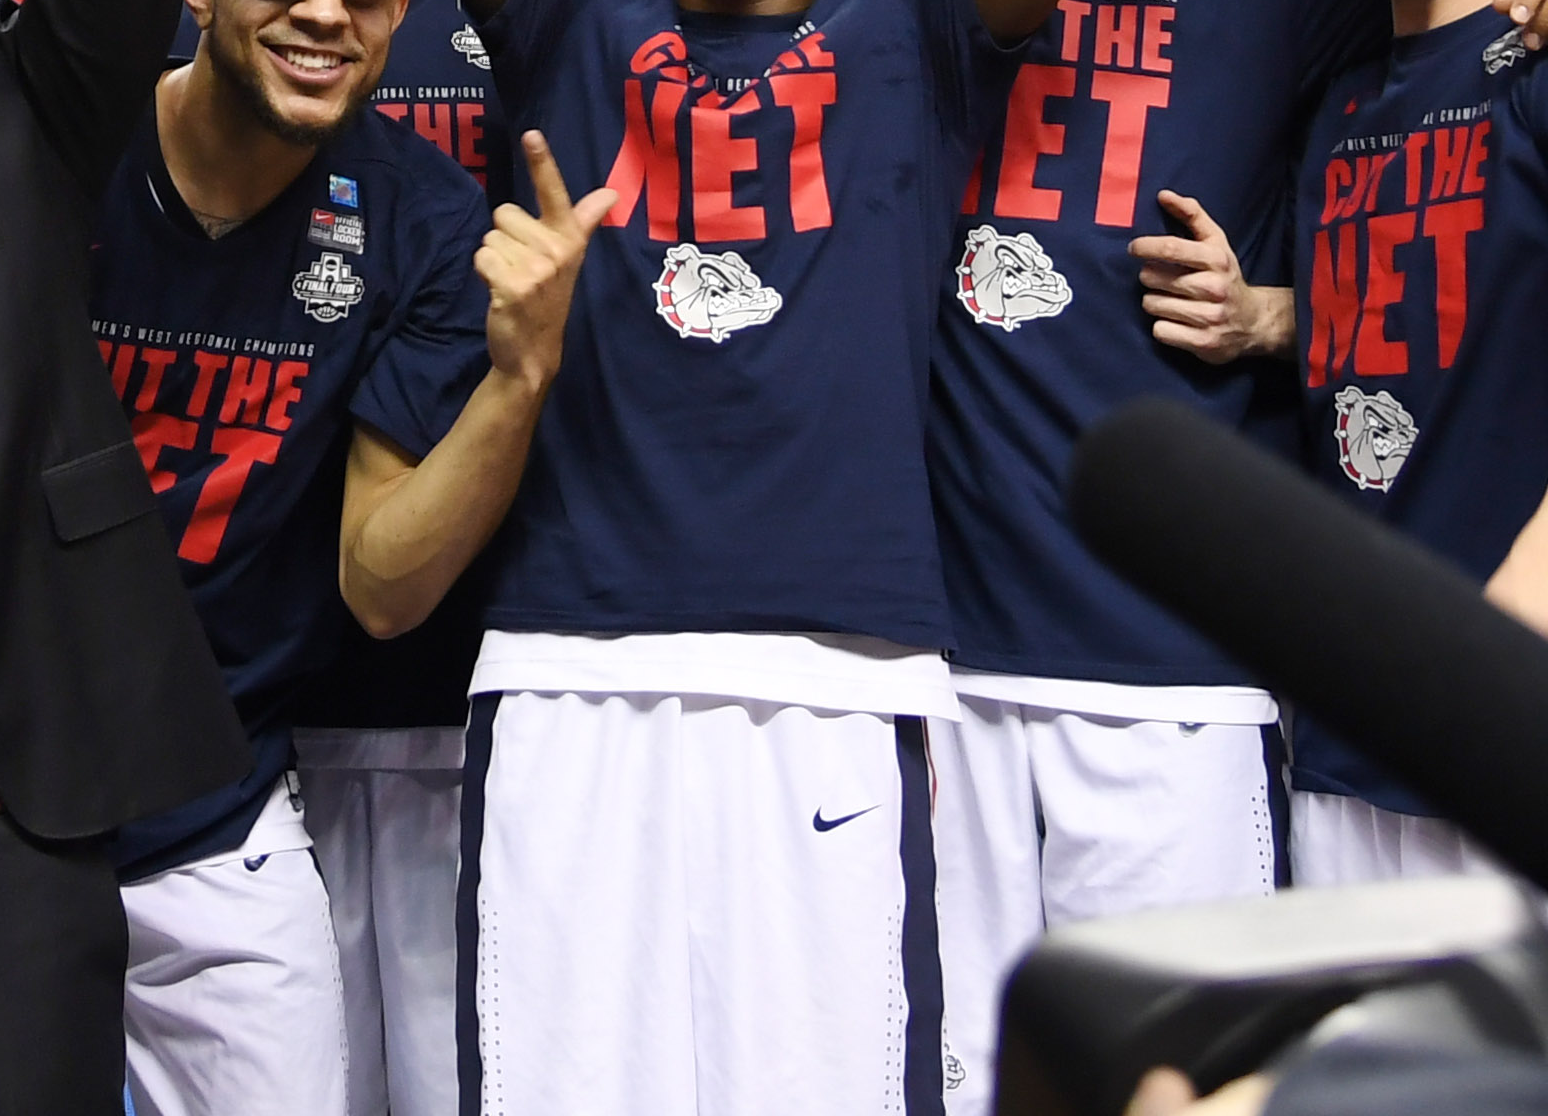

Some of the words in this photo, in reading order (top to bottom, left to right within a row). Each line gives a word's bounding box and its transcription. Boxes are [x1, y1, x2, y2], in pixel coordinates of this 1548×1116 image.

[371, 87, 411, 100] IONAL
[418, 87, 485, 99] CHAMPIONS
[601, 72, 837, 243] NET
[964, 63, 1171, 228] ET
[1403, 120, 1492, 206] THE
[332, 233, 361, 246] ROOM
[334, 224, 362, 236] LOCKER
[301, 280, 328, 293] FINAL
[330, 283, 356, 294] FOUR
[1307, 198, 1486, 388] NET
[92, 320, 131, 339] MEN'S
[138, 328, 171, 344] WEST
[178, 333, 236, 351] REGIONAL
[243, 338, 315, 358] CHAMPIONS
[97, 340, 177, 412] UT
[187, 350, 310, 431] THE
[132, 413, 283, 564] ET
